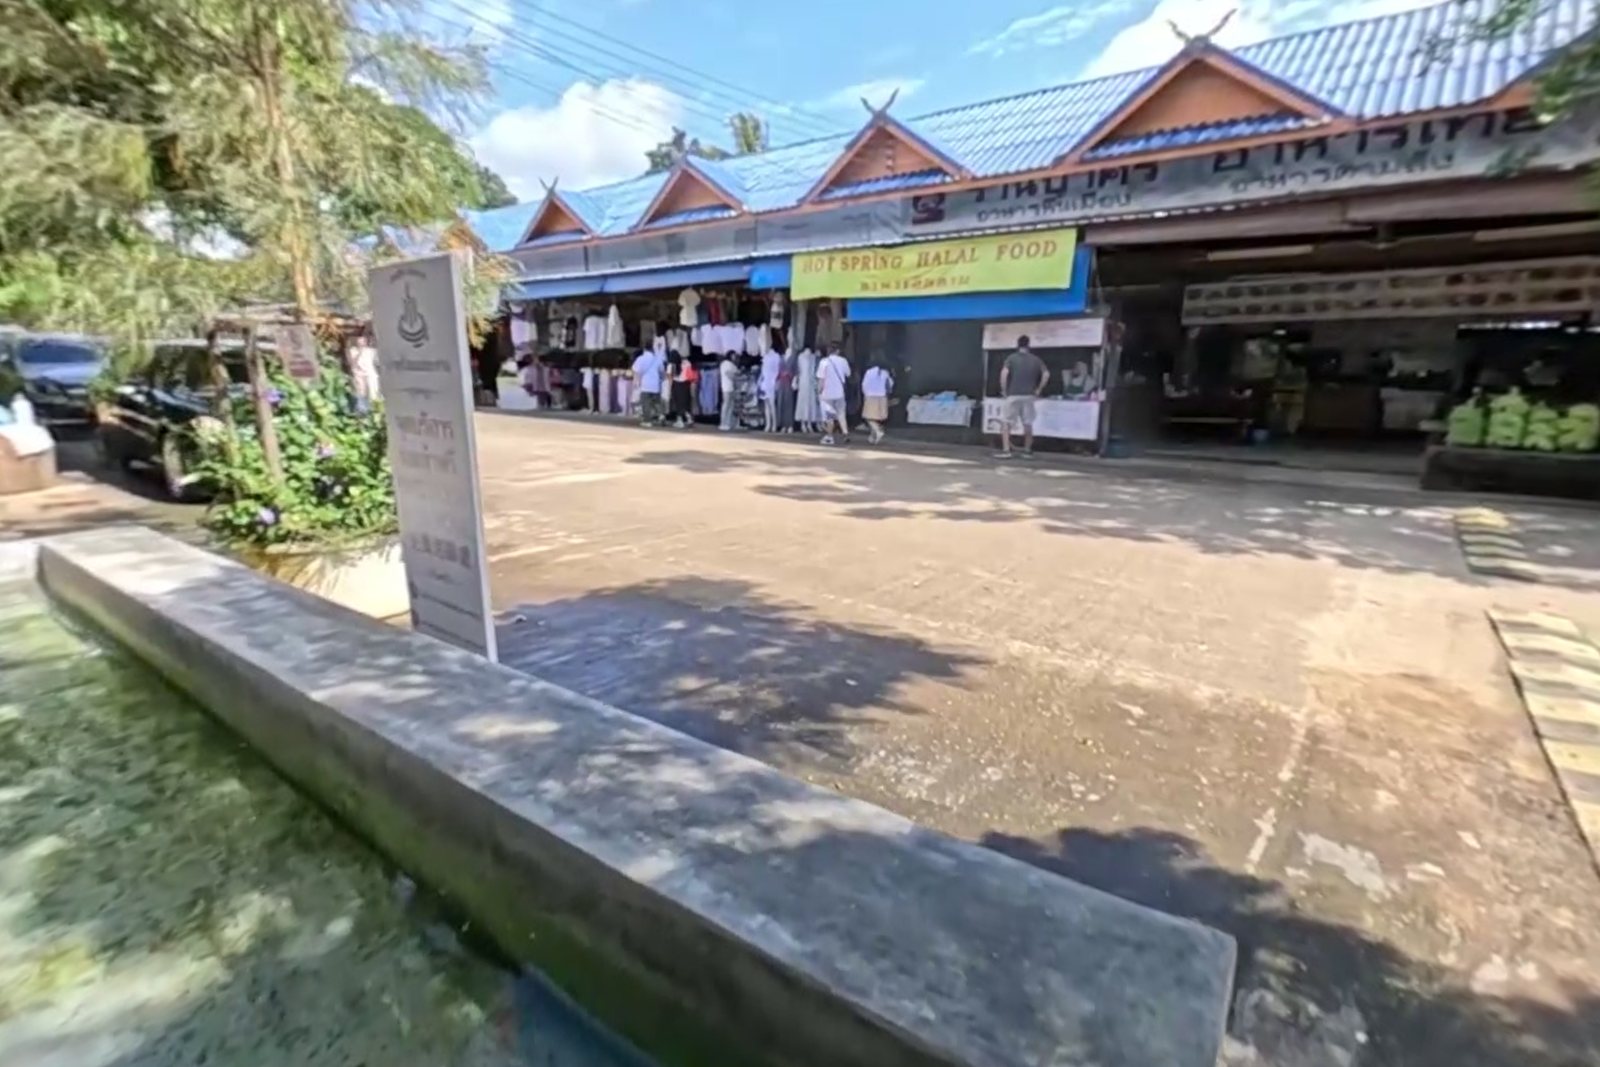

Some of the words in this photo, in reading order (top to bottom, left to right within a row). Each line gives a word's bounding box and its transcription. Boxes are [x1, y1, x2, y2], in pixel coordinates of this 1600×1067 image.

[803, 255, 836, 274] HOT
[841, 252, 903, 272] SPRING
[916, 247, 980, 268] HALAL
[997, 240, 1057, 261] FOOD
